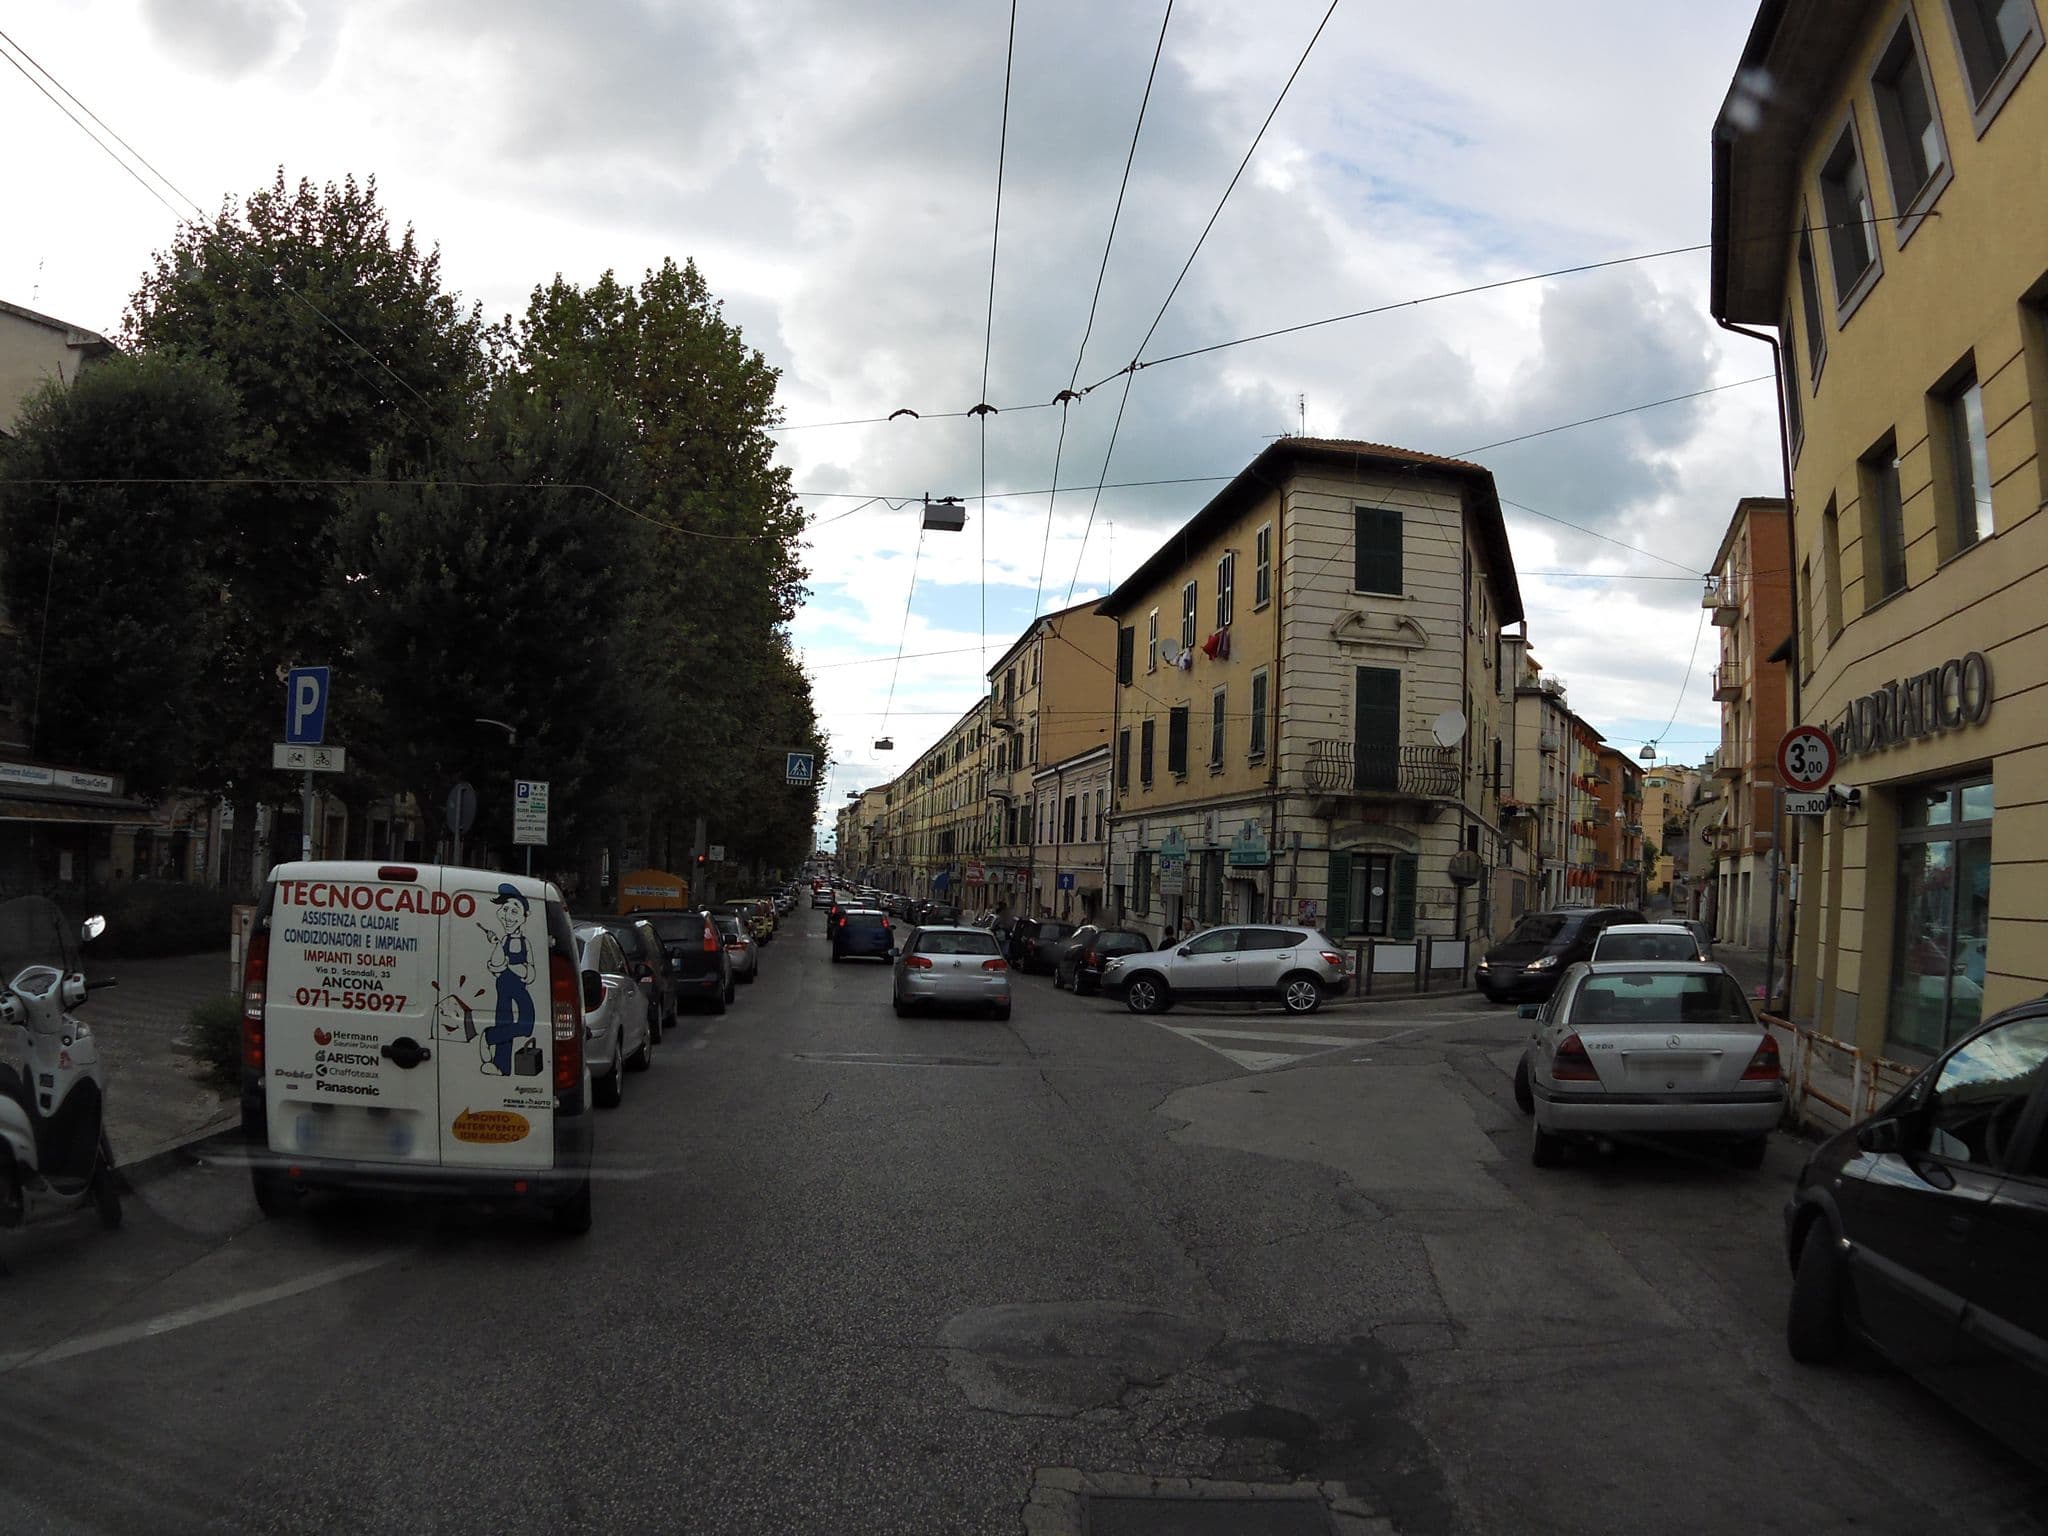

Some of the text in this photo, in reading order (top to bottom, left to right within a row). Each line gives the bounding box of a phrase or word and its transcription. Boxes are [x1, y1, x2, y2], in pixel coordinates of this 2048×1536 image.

[294, 676, 320, 736] P
[1843, 652, 1987, 754] ADRIATICO
[279, 880, 476, 918] TECNOCALDO
[302, 911, 400, 931] ASSISTENZA CALDAIE
[284, 928, 418, 952] CONDIZIONATORI E IMPIANTI
[304, 949, 396, 967] IMPIANTI SOLARI
[316, 966, 328, 974] Via
[322, 976, 383, 991] ANCONA
[295, 987, 407, 1013] 071-55097
[333, 1030, 378, 1041] Hermann
[327, 1052, 380, 1066] ARISTON
[316, 1080, 380, 1096] Panasonic
[467, 1113, 511, 1122] PRONTO
[454, 1121, 527, 1132] INTERVENTO
